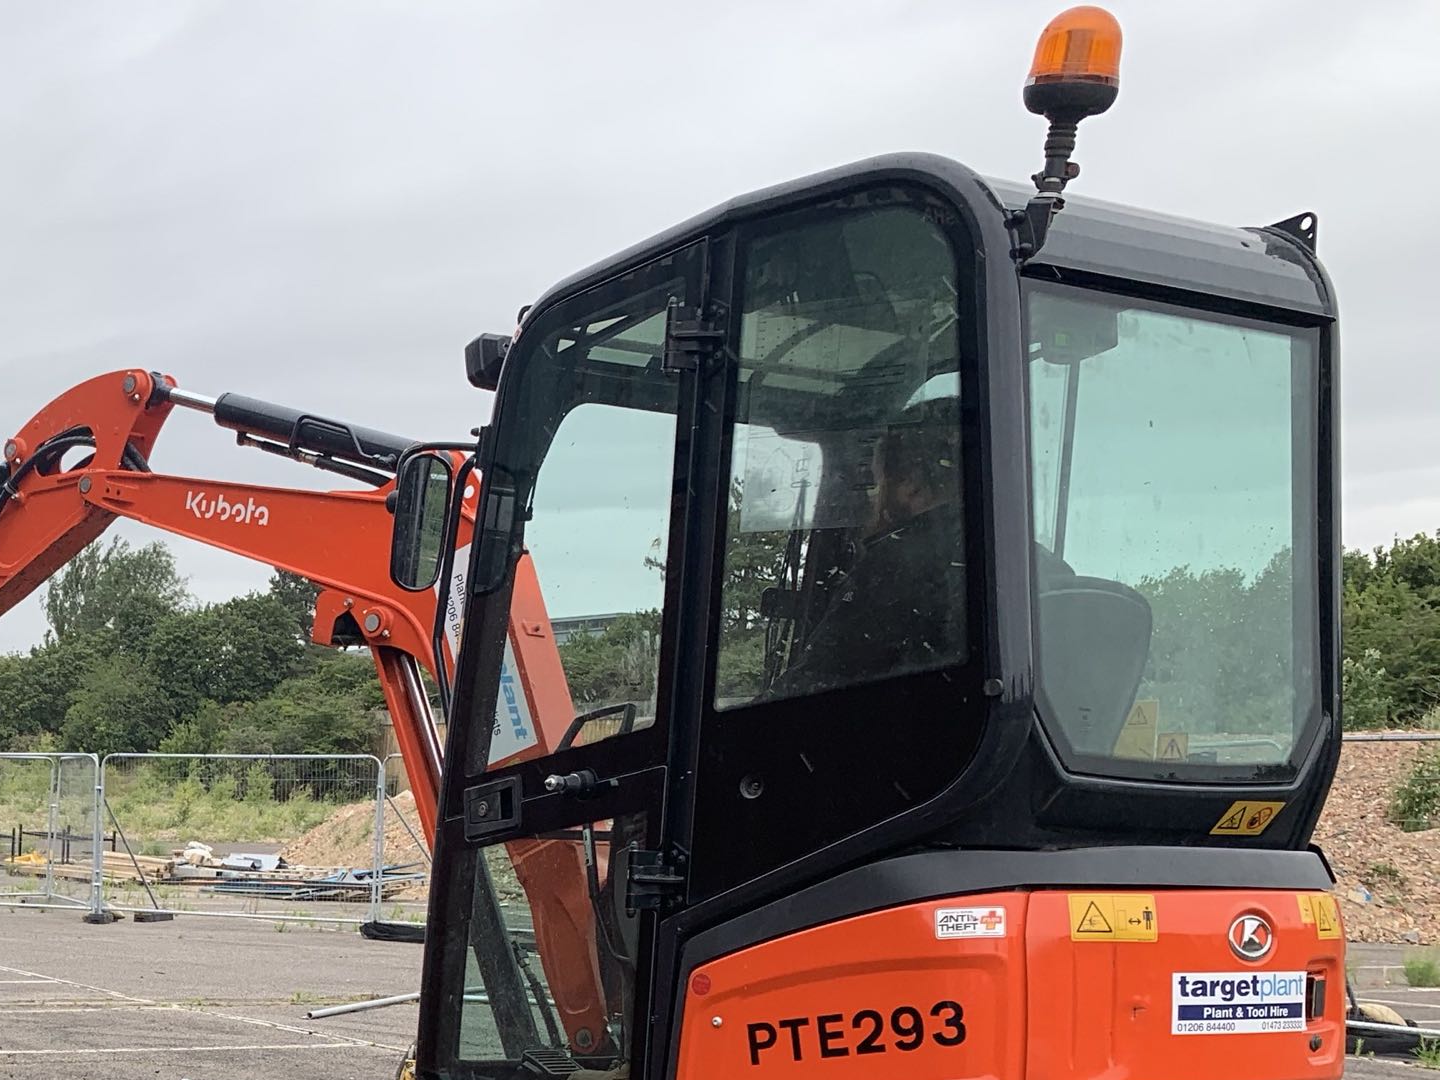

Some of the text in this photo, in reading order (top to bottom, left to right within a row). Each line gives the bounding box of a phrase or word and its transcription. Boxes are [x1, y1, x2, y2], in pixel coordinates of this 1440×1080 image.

[185, 491, 269, 526] Kubota
[939, 914, 970, 924] ANTI
[939, 923, 978, 932] THEFT
[1178, 974, 1304, 1002] targetplant
[1203, 1006, 1289, 1019] Plant & Tool Hire
[746, 1000, 966, 1065] PTE293
[1177, 1023, 1204, 1032] 01206
[1206, 1022, 1236, 1031] 844400
[1262, 1021, 1281, 1030] 01473
